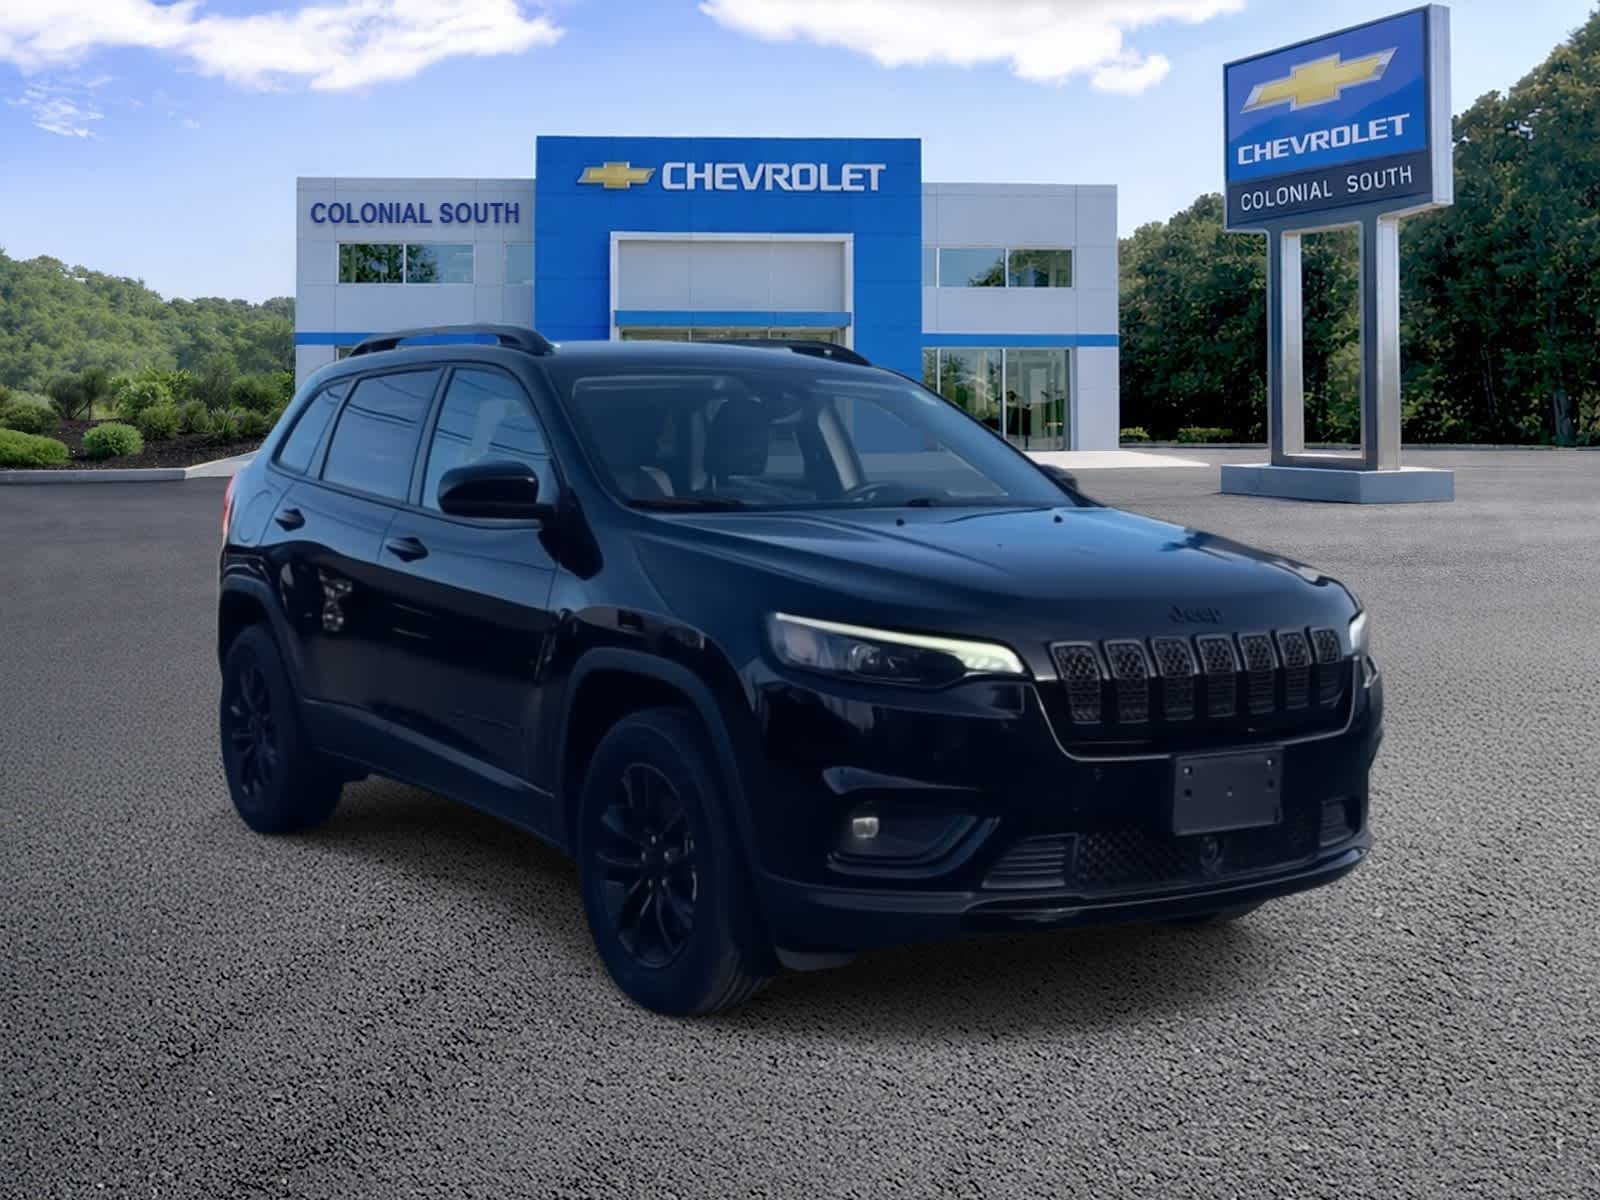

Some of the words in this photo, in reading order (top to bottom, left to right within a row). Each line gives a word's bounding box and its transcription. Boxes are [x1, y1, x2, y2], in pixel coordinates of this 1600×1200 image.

[1237, 113, 1410, 165] CHEVROLET
[662, 162, 886, 192] CHEVROLET
[1240, 180, 1333, 211] COLONIAL
[1346, 165, 1413, 193] SOUTH
[311, 202, 432, 224] COLONIAL
[439, 202, 520, 224] SOUTH
